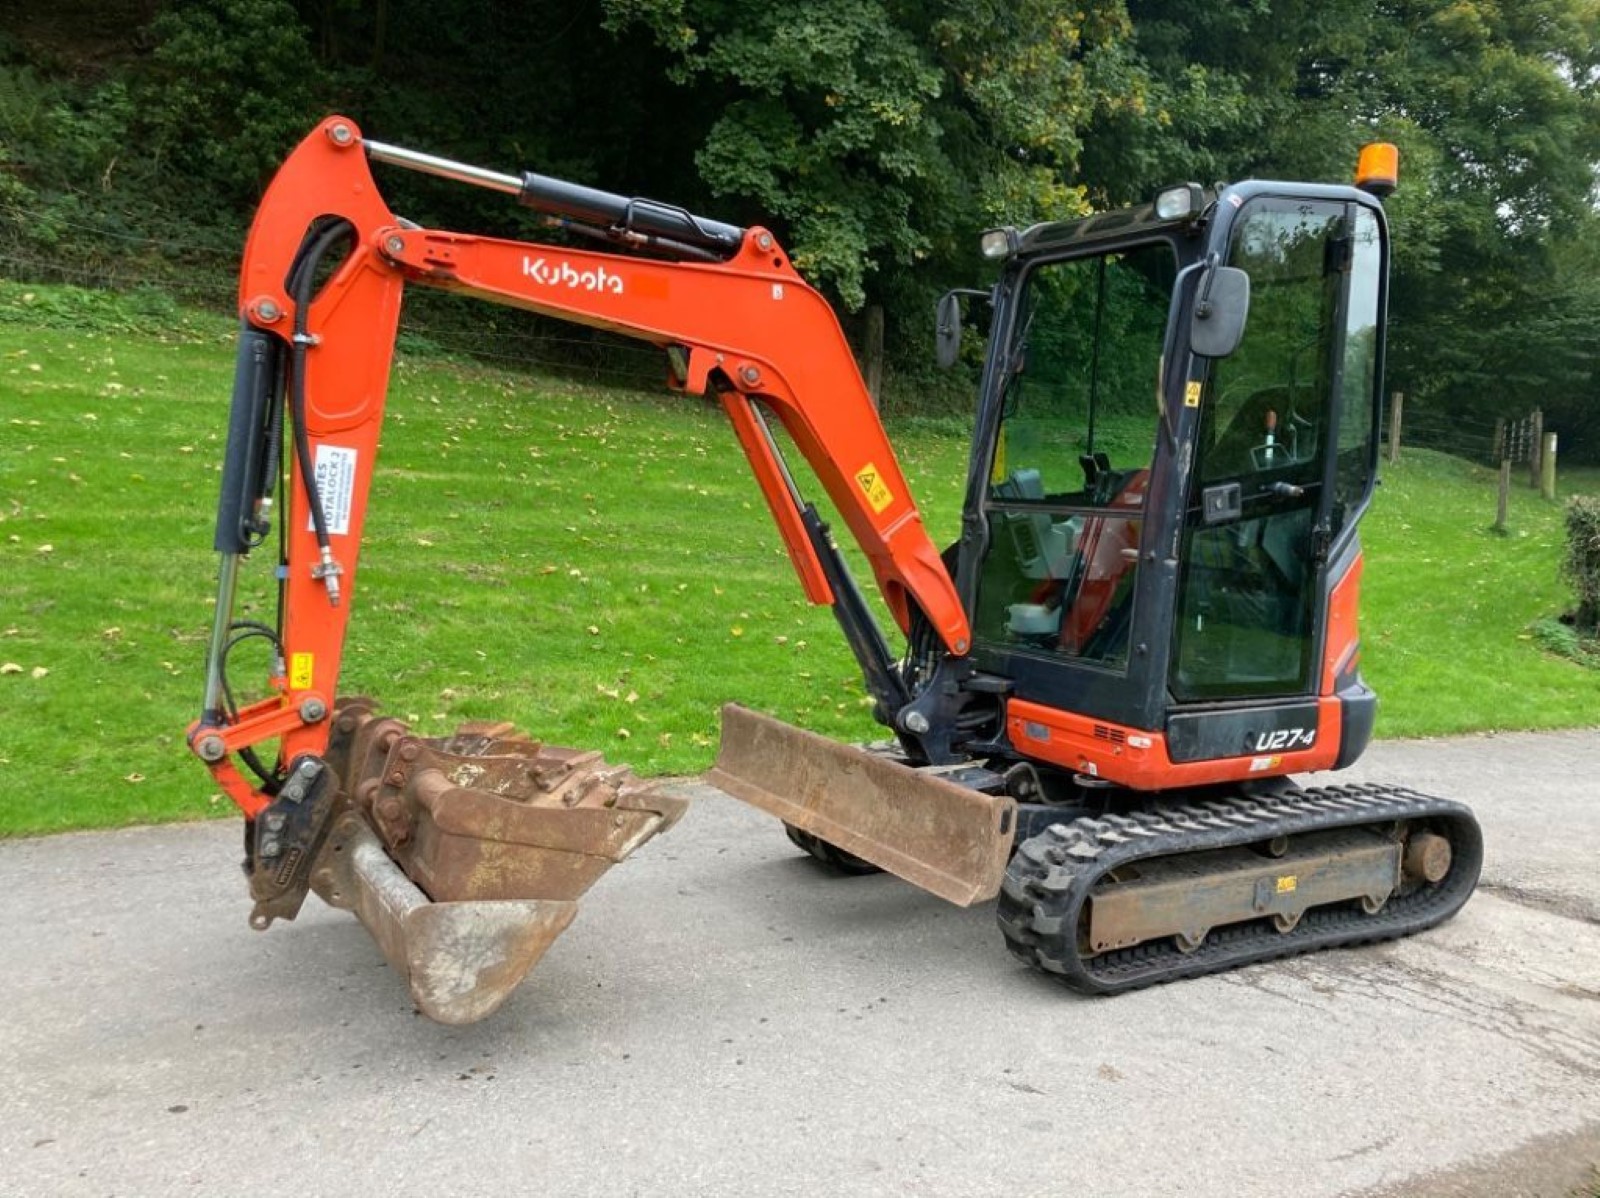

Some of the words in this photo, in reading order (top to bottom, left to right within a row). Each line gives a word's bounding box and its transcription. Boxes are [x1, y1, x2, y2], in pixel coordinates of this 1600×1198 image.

[523, 256, 624, 293] Kubota
[325, 461, 338, 527] TOTALOCK
[1256, 728, 1316, 751] U27-4
